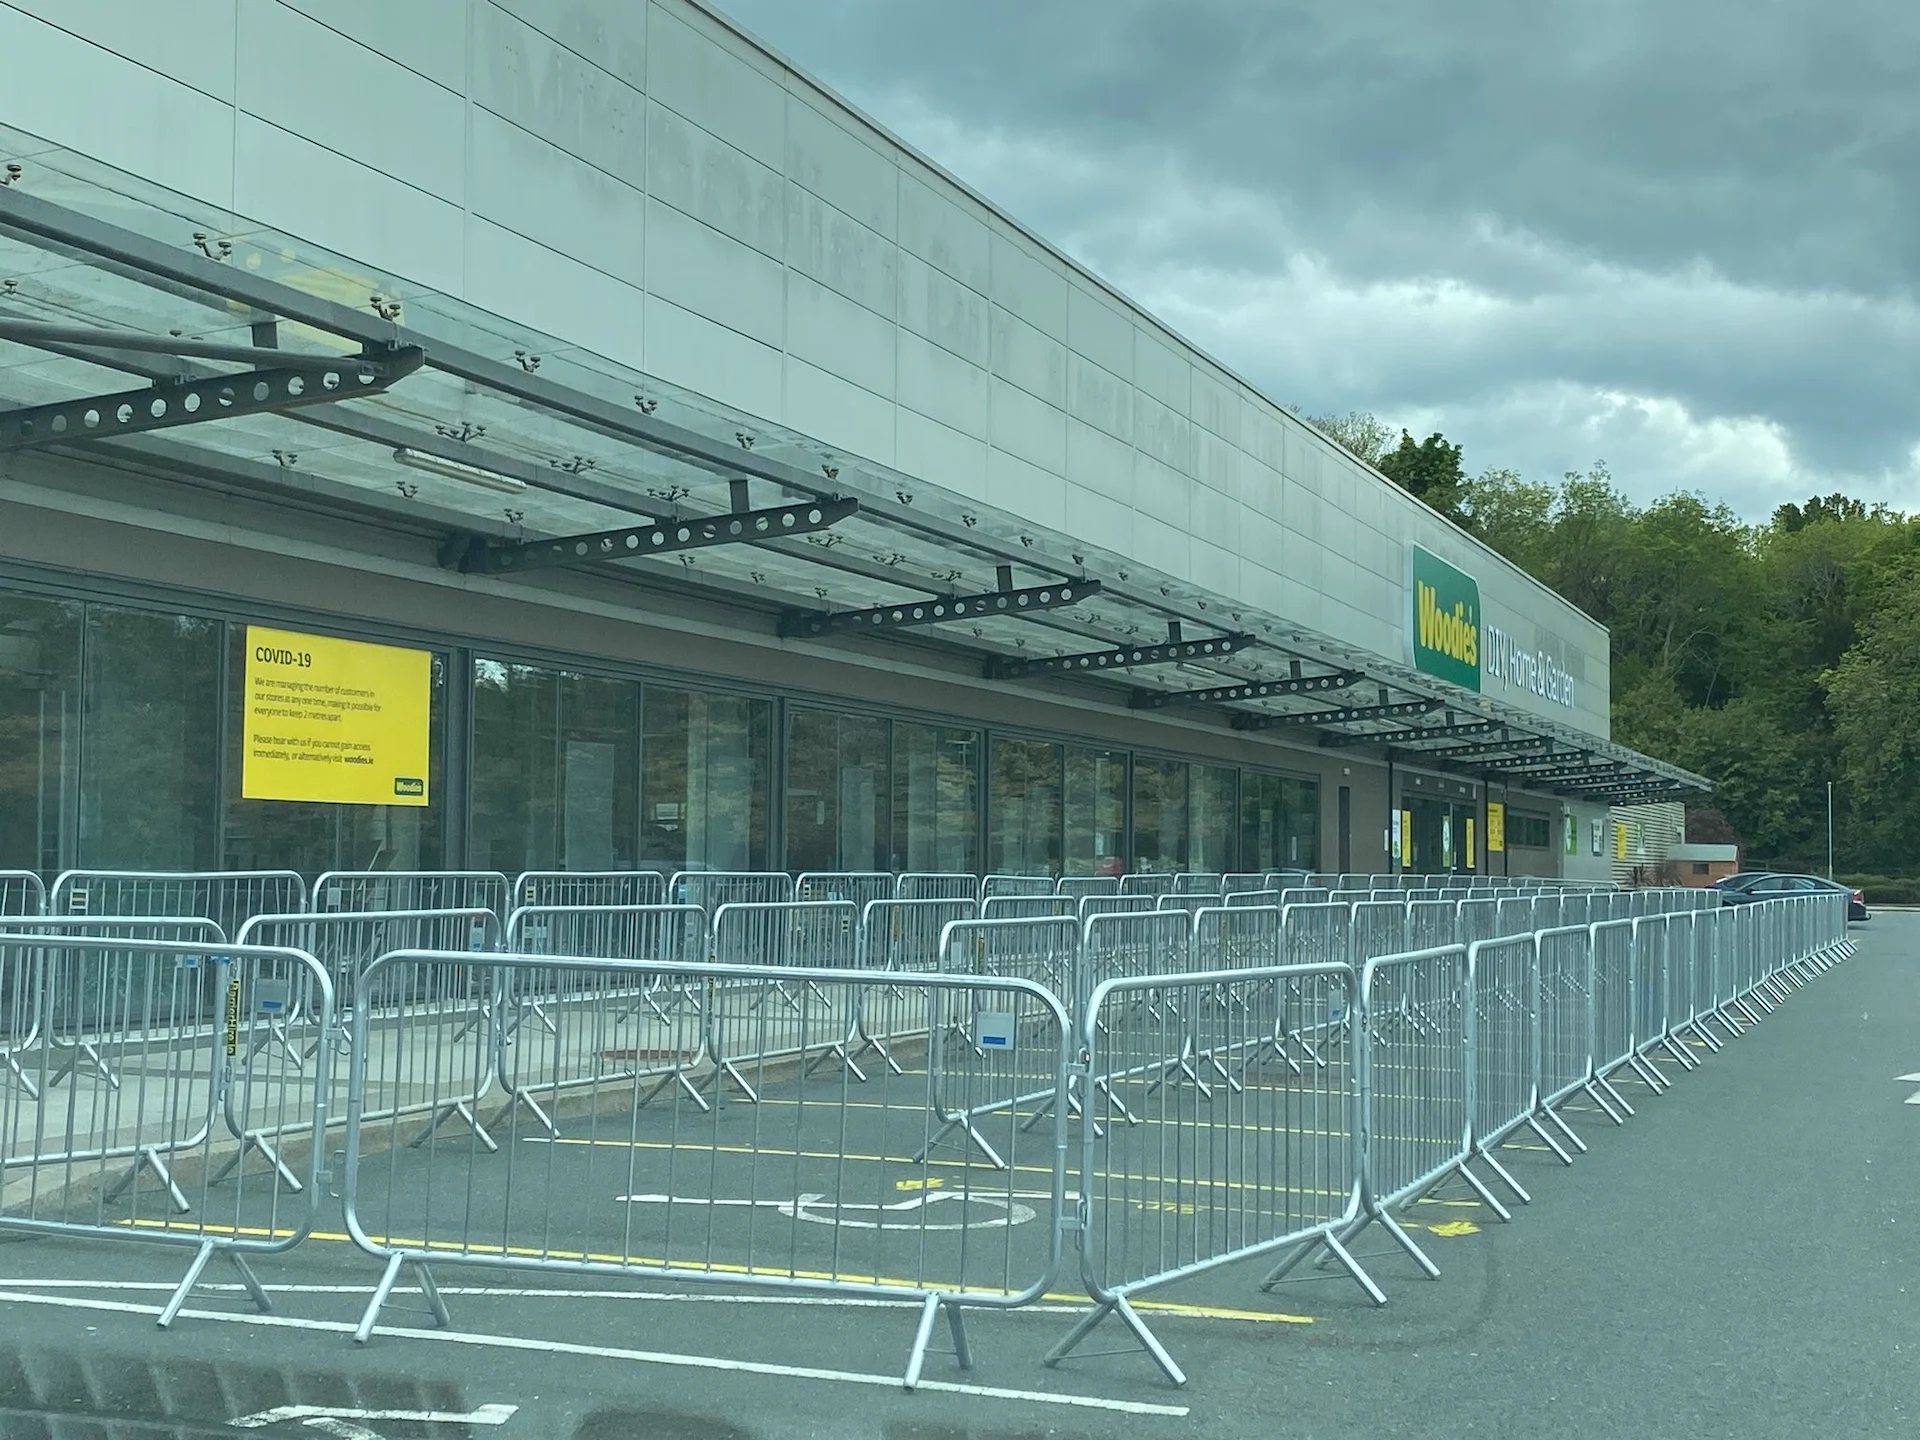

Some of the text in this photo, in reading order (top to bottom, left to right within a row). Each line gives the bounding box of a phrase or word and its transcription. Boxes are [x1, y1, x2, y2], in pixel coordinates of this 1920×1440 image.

[1418, 580, 1477, 667] Woodie's
[255, 646, 311, 668] COVID-19
[1487, 625, 1575, 708] DIY, Home & Garden
[276, 681, 303, 693] managing
[314, 685, 333, 694] number
[341, 688, 369, 698] customers
[266, 693, 284, 702] stores
[313, 697, 327, 709] time,
[328, 699, 346, 710] making
[351, 701, 372, 711] possible
[254, 708, 282, 718] everyone
[289, 709, 303, 720] keep
[308, 711, 327, 720] metres
[328, 713, 342, 723] apart.
[253, 734, 272, 743] Please
[273, 735, 287, 744] bear
[287, 737, 299, 745] with
[323, 741, 340, 749] cannot
[341, 741, 353, 751] gain
[253, 749, 290, 761] immediately,
[298, 752, 331, 764] alternatively
[331, 754, 343, 762] visit
[344, 755, 374, 764] woodies.ie
